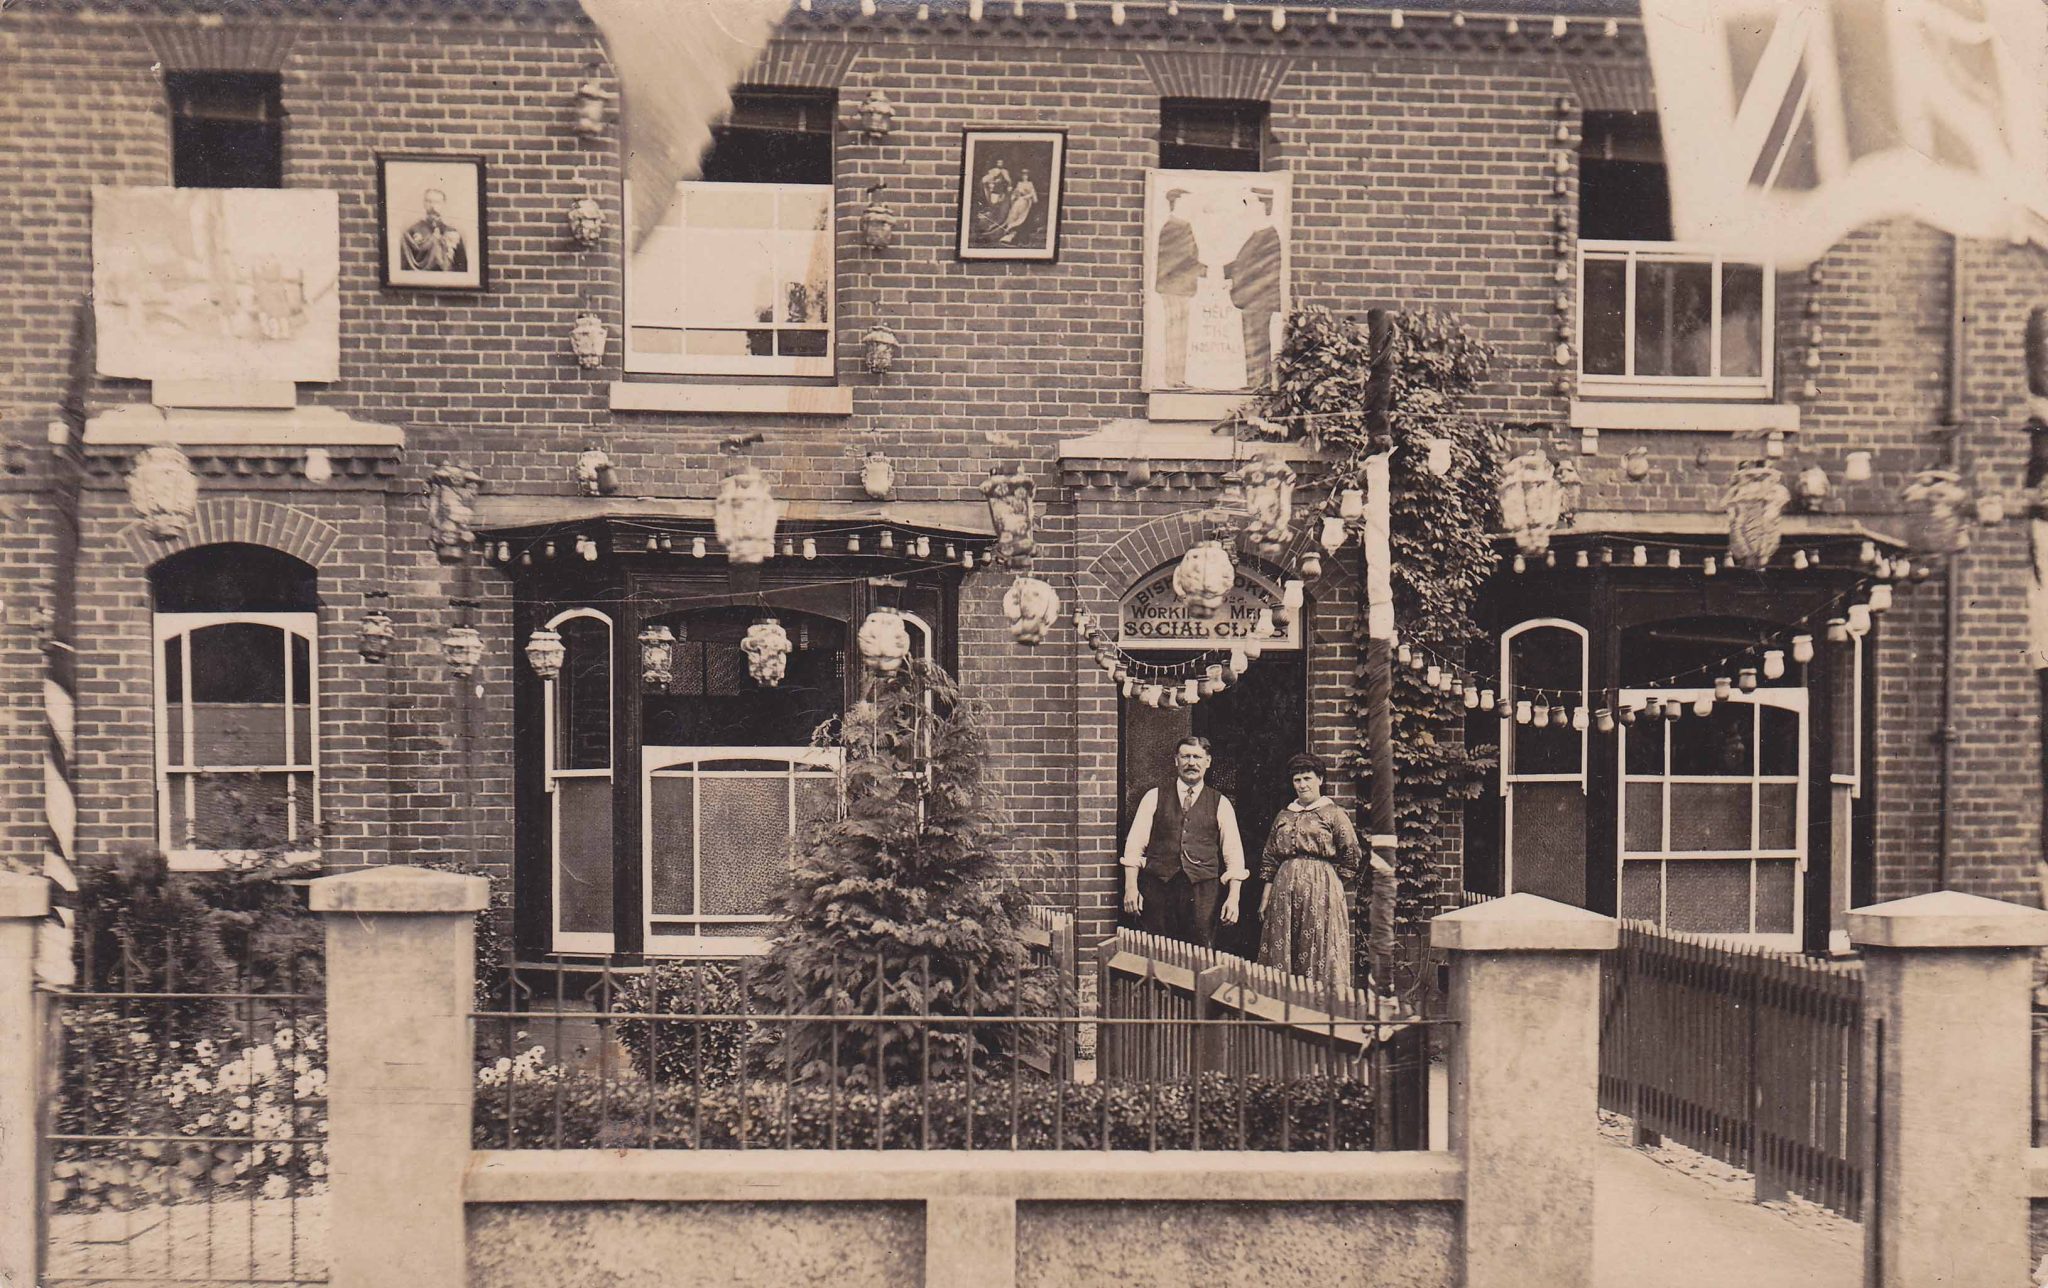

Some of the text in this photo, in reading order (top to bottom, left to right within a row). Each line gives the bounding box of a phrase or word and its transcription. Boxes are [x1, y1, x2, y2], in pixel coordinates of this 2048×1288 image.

[1202, 305, 1233, 319] HELP
[1131, 604, 1194, 619] WORKI
[1124, 621, 1210, 637] SOCIAL
